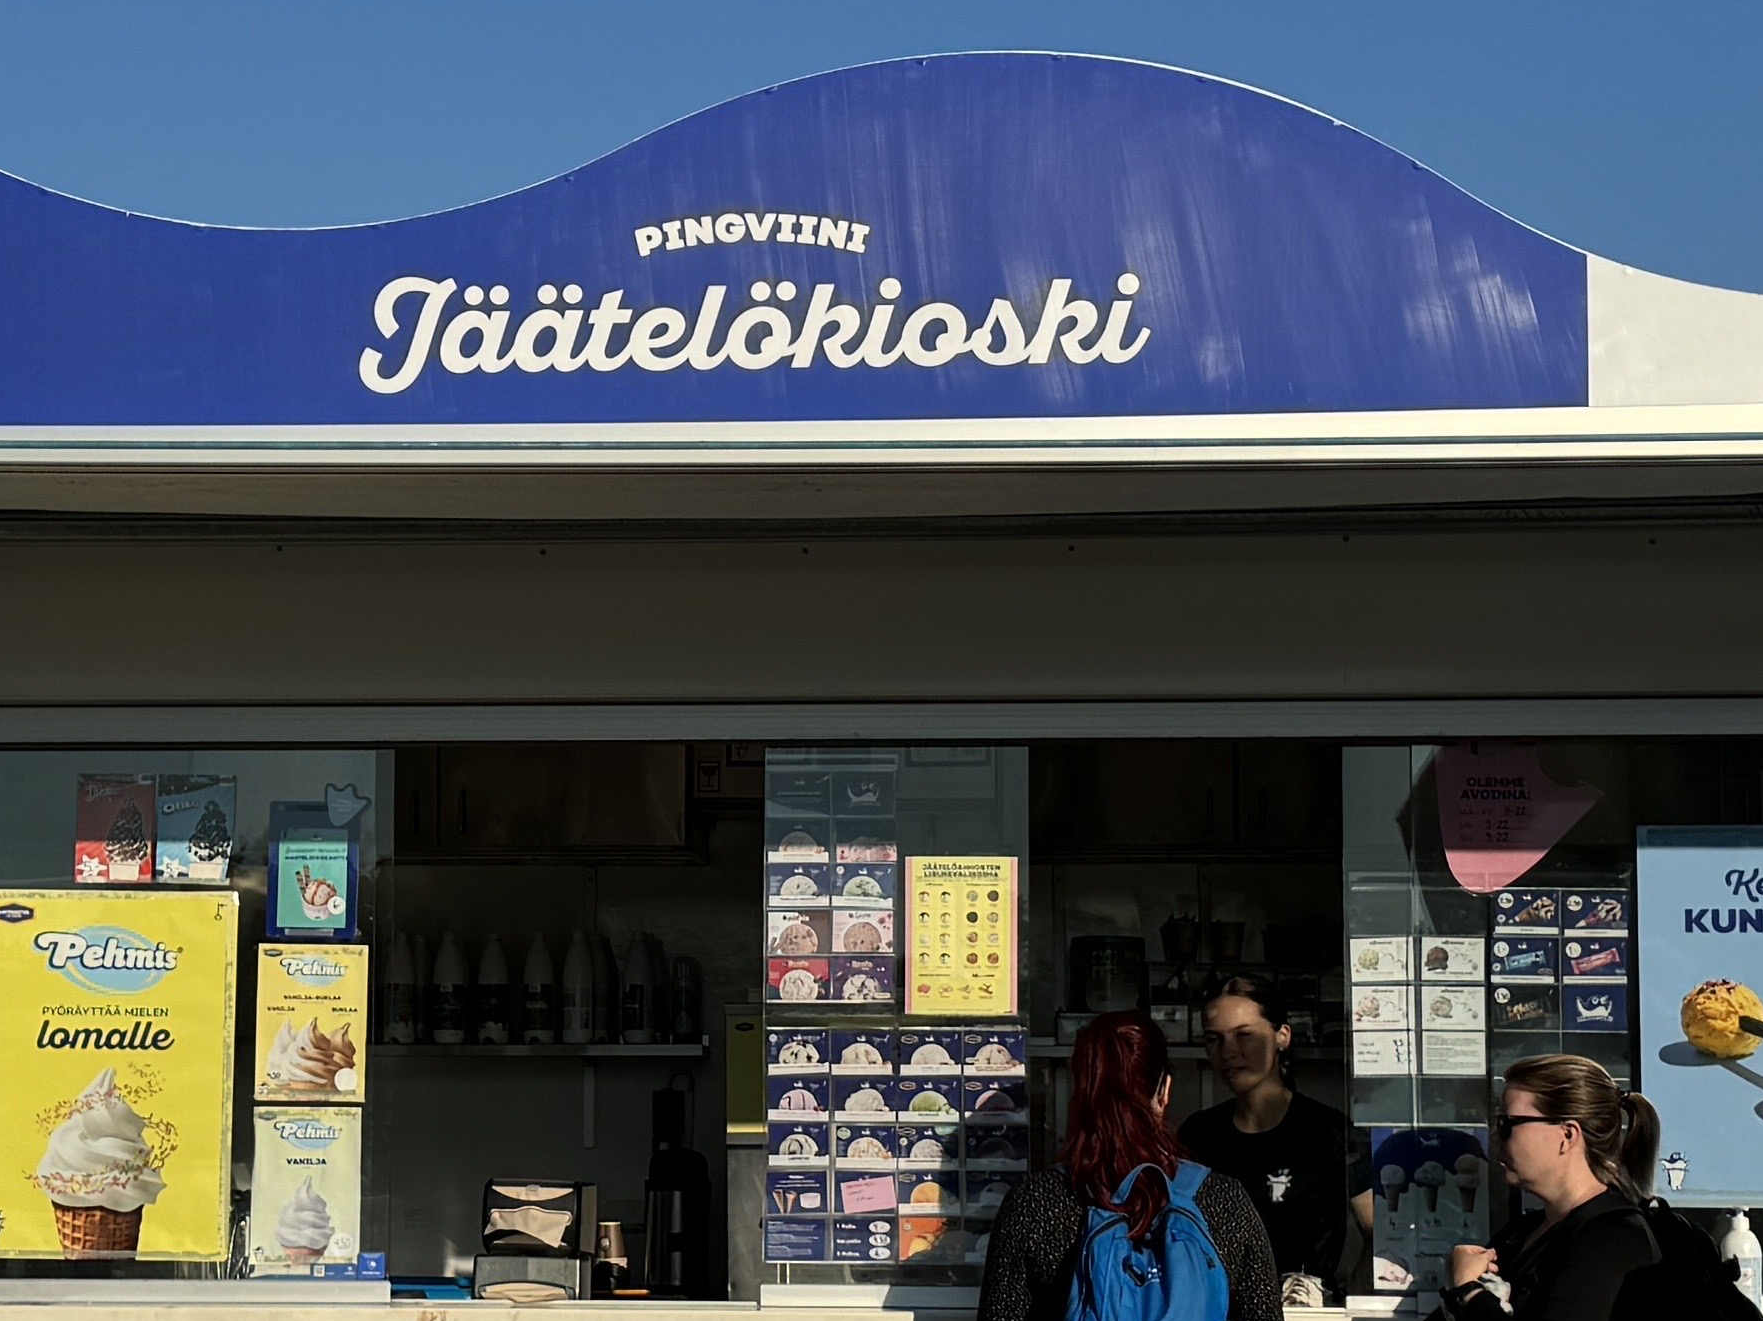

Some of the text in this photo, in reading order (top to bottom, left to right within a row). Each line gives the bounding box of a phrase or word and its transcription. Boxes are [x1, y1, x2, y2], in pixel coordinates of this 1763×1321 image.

[634, 212, 872, 258] PINGVIINI
[358, 272, 1151, 395] Jäätelökioski
[1466, 777, 1525, 788] OLEMME
[34, 931, 180, 972] Pehmis
[42, 1004, 169, 1017] PYÖRÄYTTÄÄ MIELEN
[36, 1019, 175, 1051] lomalle
